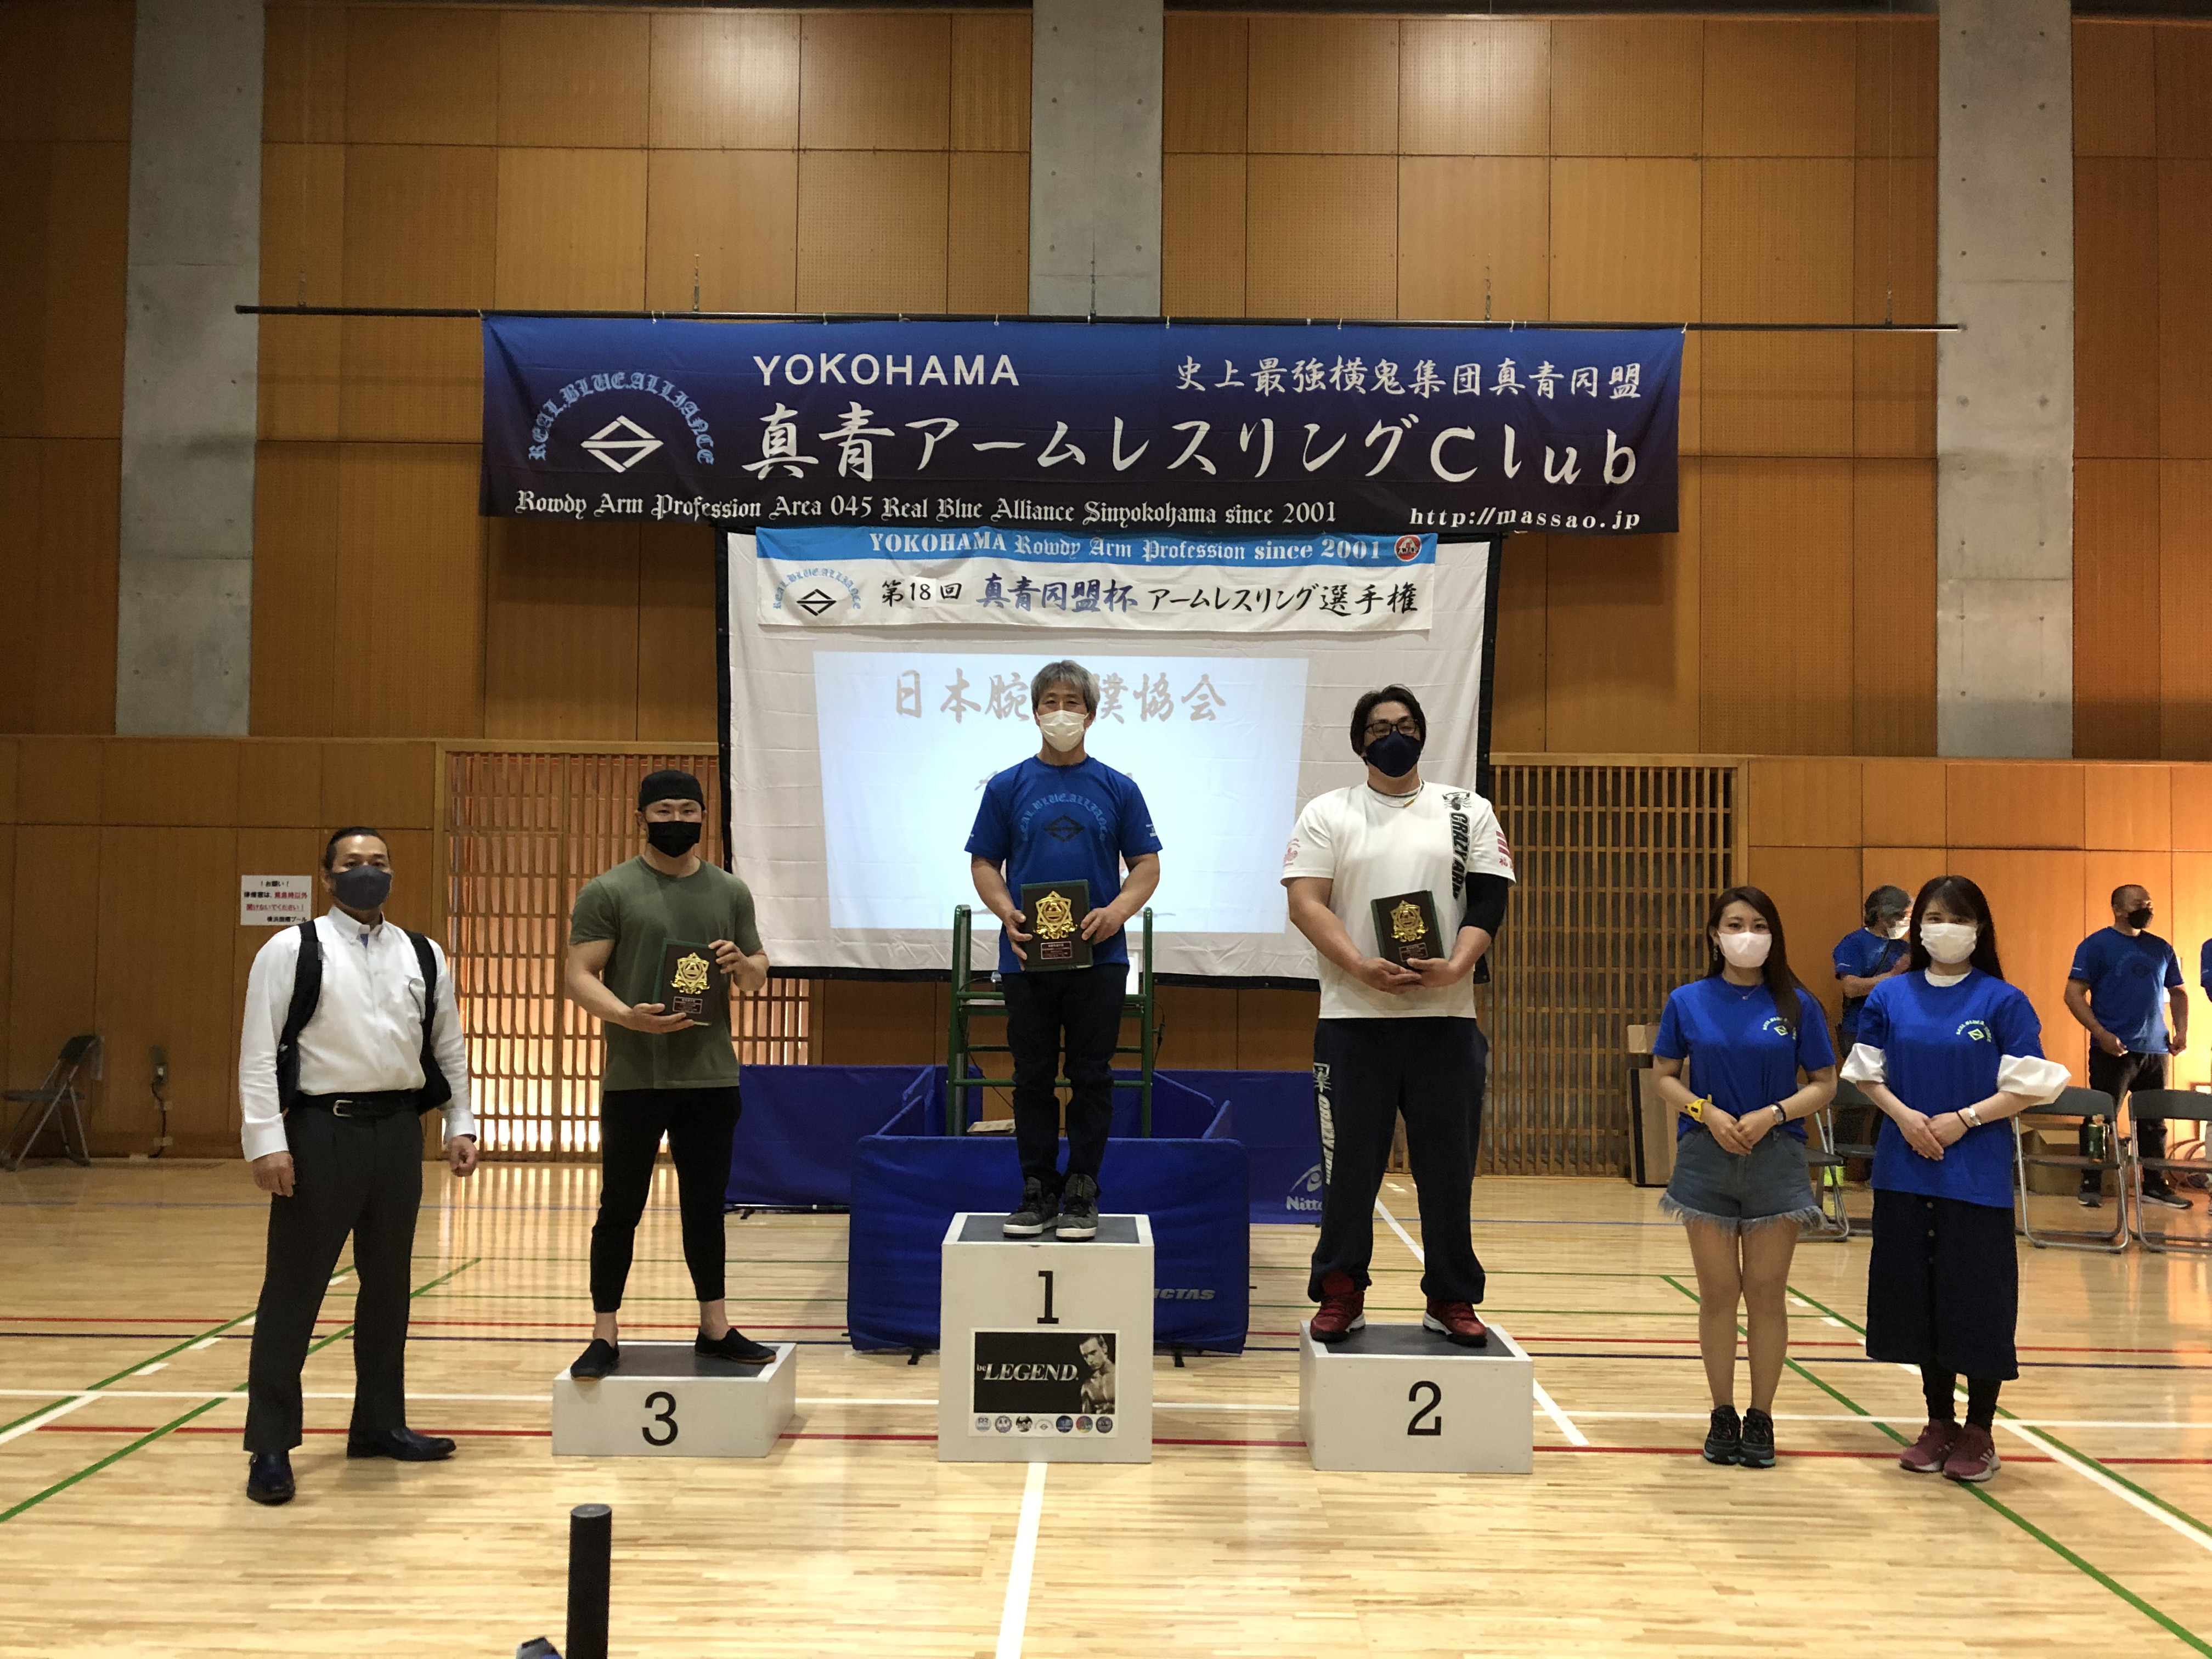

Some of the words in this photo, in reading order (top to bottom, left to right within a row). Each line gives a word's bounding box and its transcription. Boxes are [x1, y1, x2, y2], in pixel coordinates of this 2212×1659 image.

[753, 353, 1019, 386] YOKOHAMA
[515, 490, 587, 520] Rowdy
[593, 493, 644, 518] Arm
[651, 494, 762, 521] Profession
[769, 495, 822, 520] Area
[830, 495, 873, 518] 045
[881, 496, 928, 521] Real
[935, 498, 983, 522] Blue
[990, 498, 1075, 522] Alliance
[1082, 501, 1216, 528] Sinyokohama
[1225, 503, 1273, 524] since
[1282, 501, 1336, 524] 2001
[1409, 507, 1640, 531] http://massao.jp
[870, 531, 1007, 552] YOKOHAMA
[1013, 534, 1081, 560] Rowdy
[1088, 537, 1131, 558] Arm
[1142, 539, 1246, 562] Profession
[1254, 541, 1313, 560] since
[1321, 538, 1380, 560] 2001
[882, 579, 962, 607] 第18回
[1148, 581, 1418, 617] アームレスリング選手権
[896, 667, 1227, 724] 日本腕撲協会
[1449, 811, 1470, 864] CRAZY
[1037, 1270, 1059, 1324] 1
[641, 1391, 679, 1447] 3
[1407, 1380, 1442, 1436] 2
